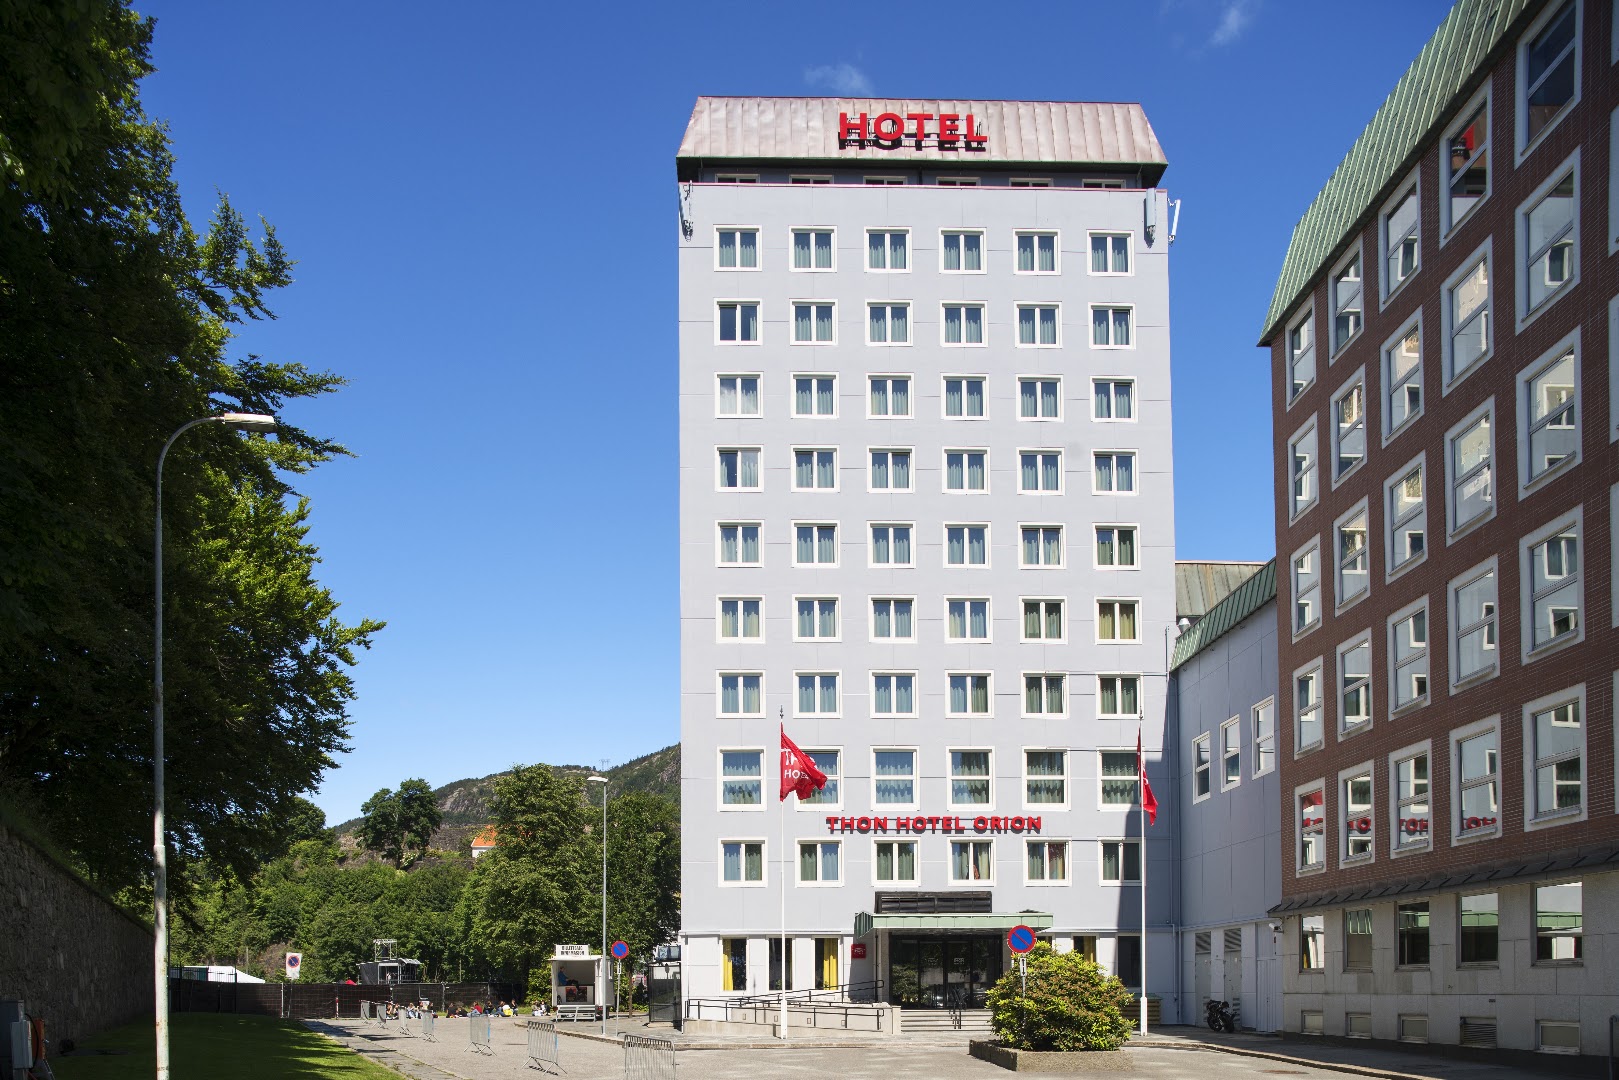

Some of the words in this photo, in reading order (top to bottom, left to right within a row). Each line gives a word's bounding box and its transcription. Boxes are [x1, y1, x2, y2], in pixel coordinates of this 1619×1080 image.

[839, 112, 988, 142] HOTEL
[826, 816, 888, 830] THON
[896, 816, 965, 830] HOTEL
[973, 816, 1042, 830] ORION
